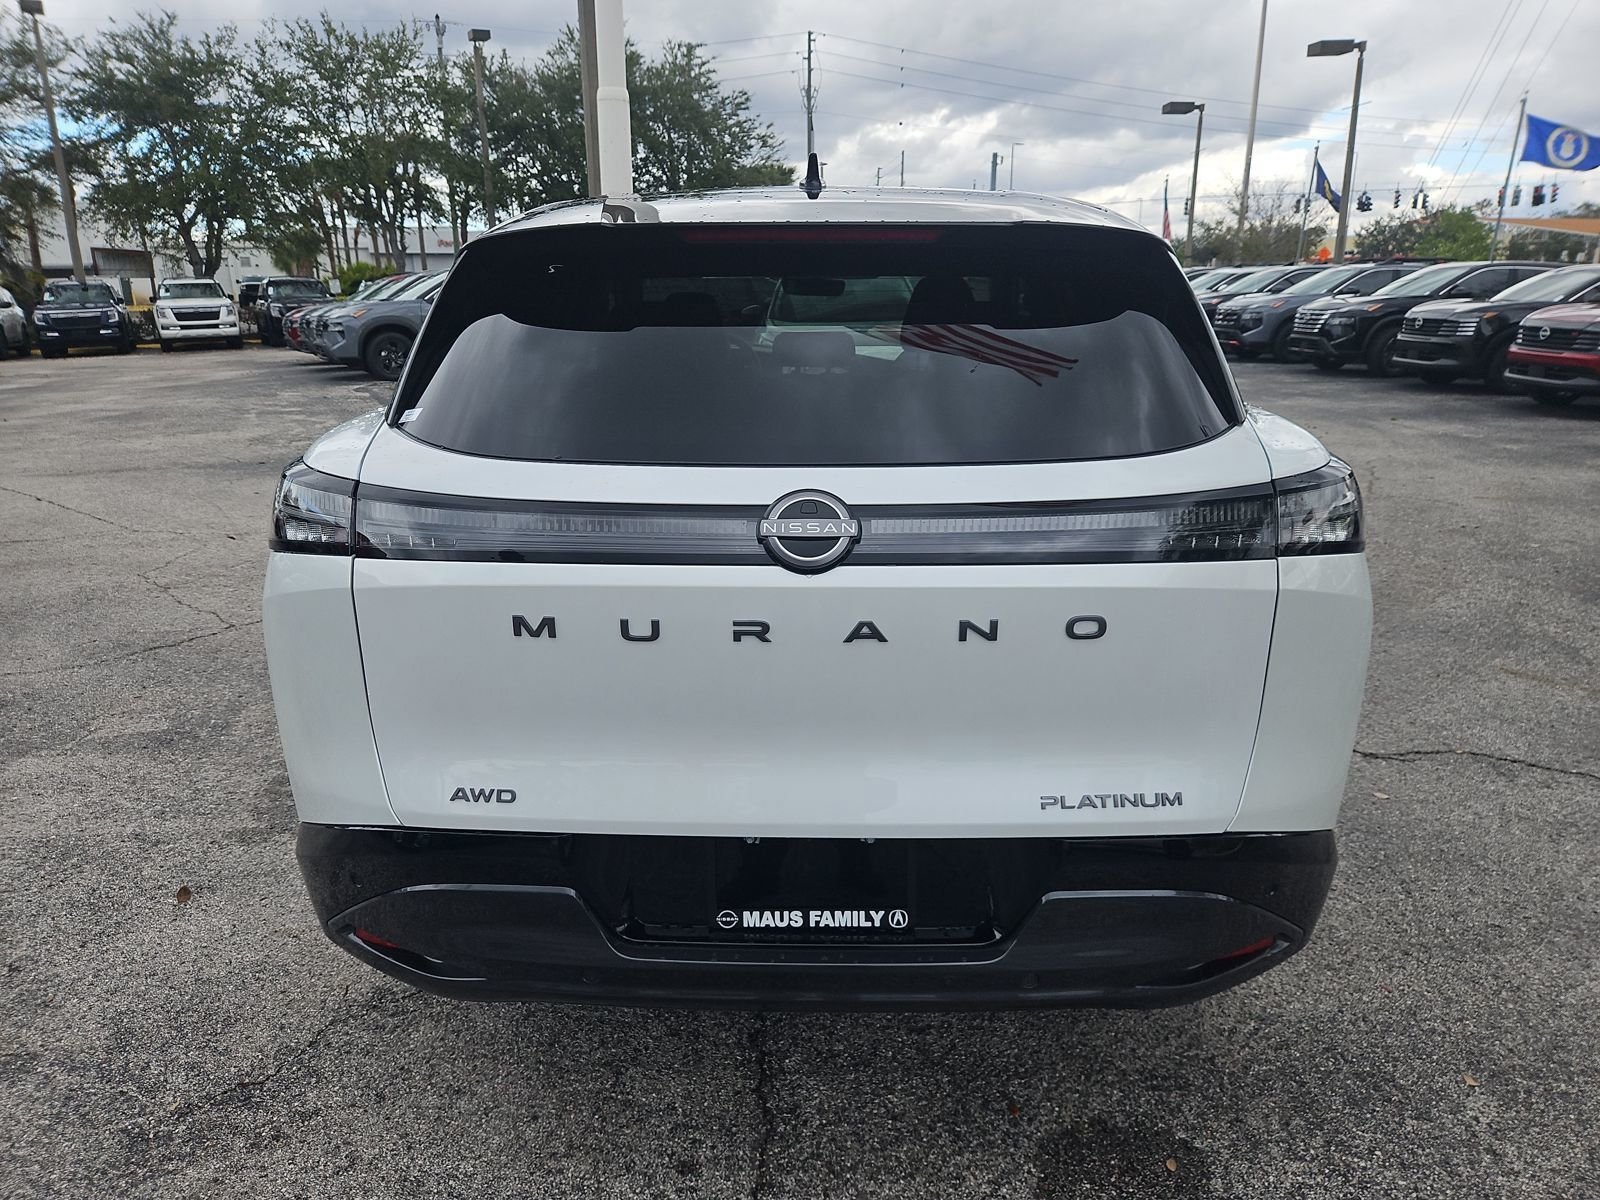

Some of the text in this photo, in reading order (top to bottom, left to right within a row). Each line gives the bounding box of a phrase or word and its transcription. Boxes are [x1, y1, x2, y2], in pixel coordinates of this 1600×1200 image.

[763, 522, 856, 533] NISSAN
[512, 614, 1107, 643] MURANO
[449, 786, 517, 804] AWD
[1040, 791, 1183, 810] PLATINUM
[743, 911, 885, 927] MAUS FAMILY
